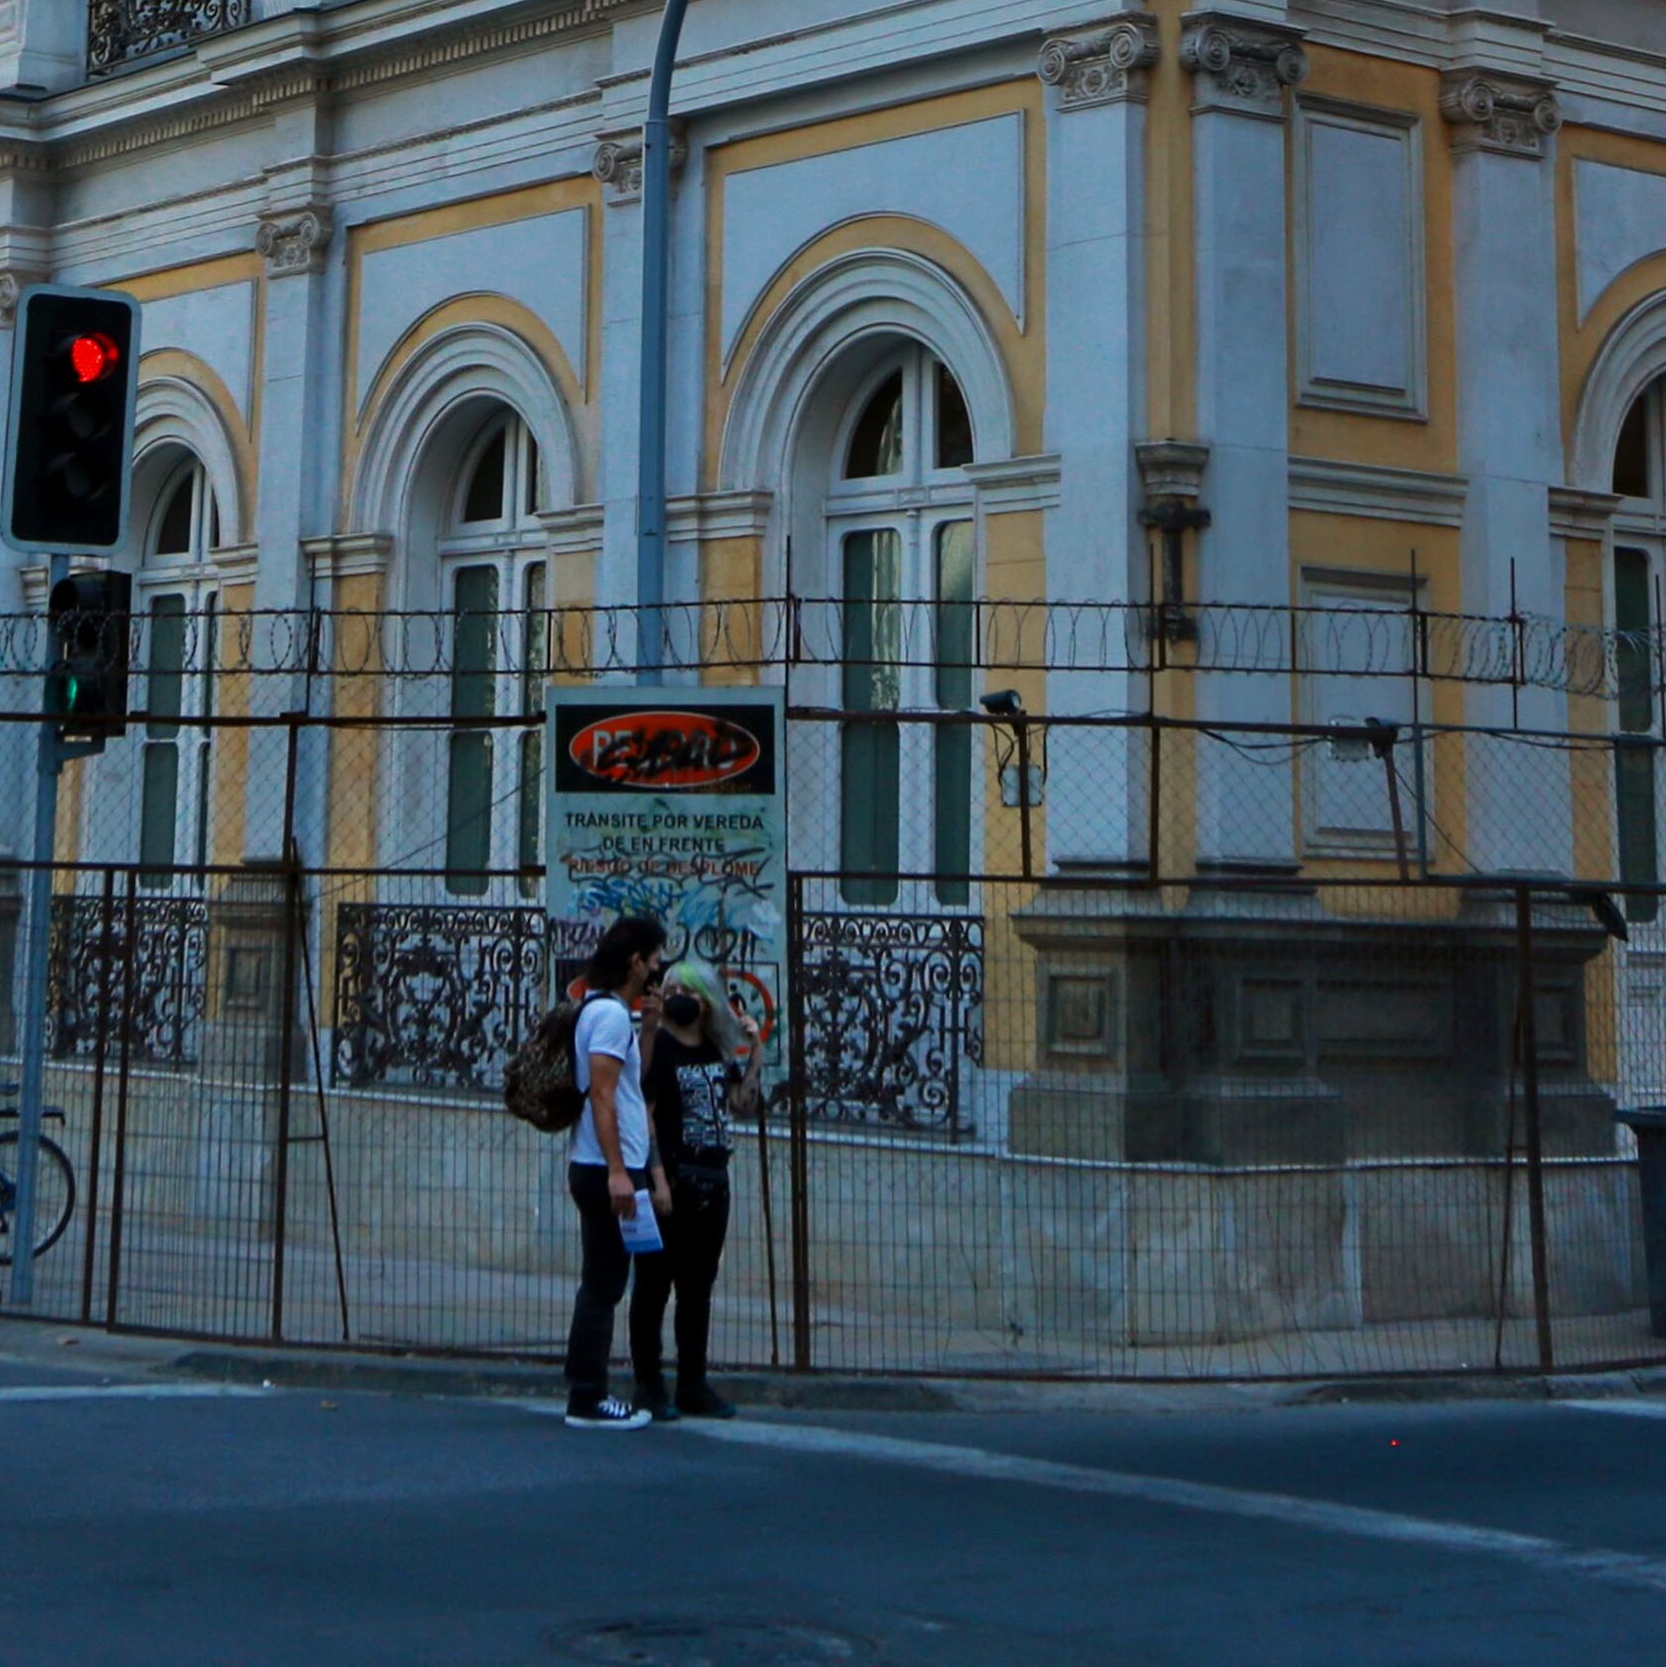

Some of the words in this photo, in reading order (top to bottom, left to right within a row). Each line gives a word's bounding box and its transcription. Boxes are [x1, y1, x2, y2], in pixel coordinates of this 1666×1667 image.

[652, 813, 687, 829] POR
[693, 814, 765, 830] VEREDA
[603, 837, 625, 851] DE
[631, 837, 653, 852] EN
[659, 837, 726, 853] FRENTE
